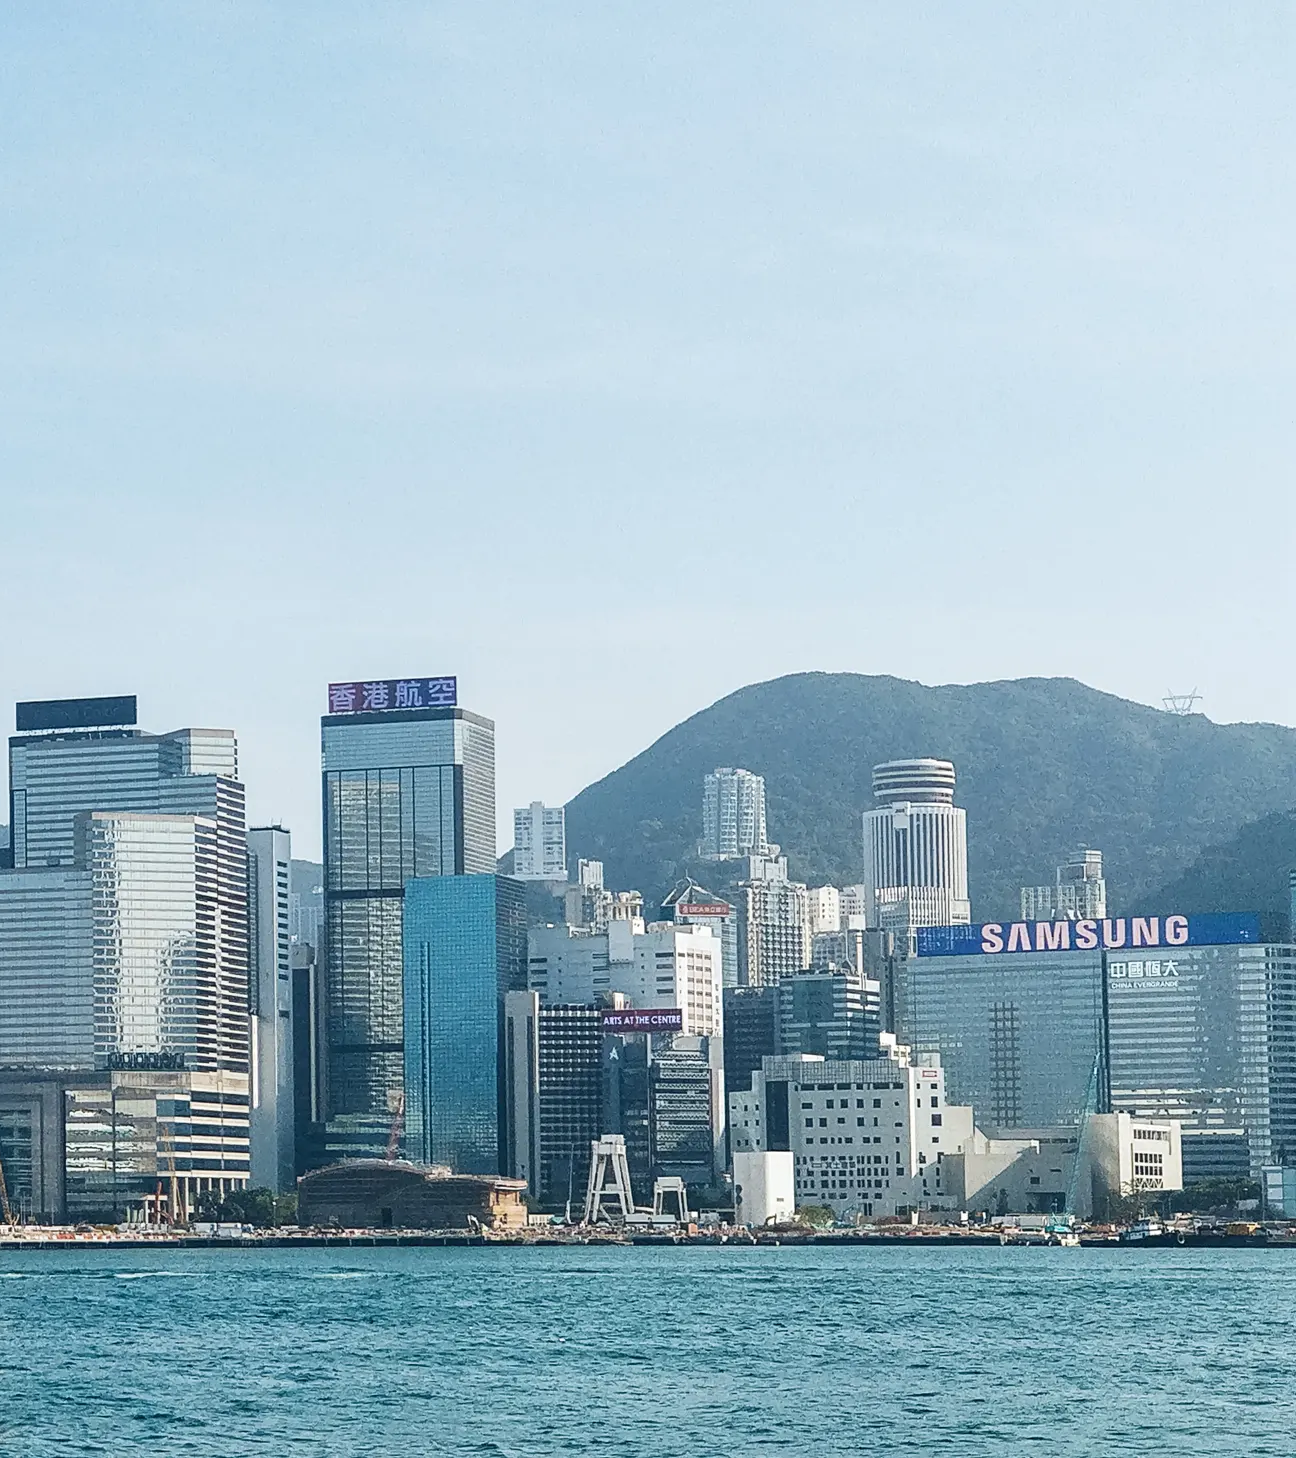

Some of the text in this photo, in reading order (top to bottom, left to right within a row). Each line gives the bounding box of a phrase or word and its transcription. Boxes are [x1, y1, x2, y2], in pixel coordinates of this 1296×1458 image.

[329, 679, 455, 711] 香港航空
[981, 915, 1189, 953] SAMSUNG
[1134, 980, 1179, 988] EVERGRANDE
[604, 1015, 681, 1025] ARTS AT THE CENTRE
